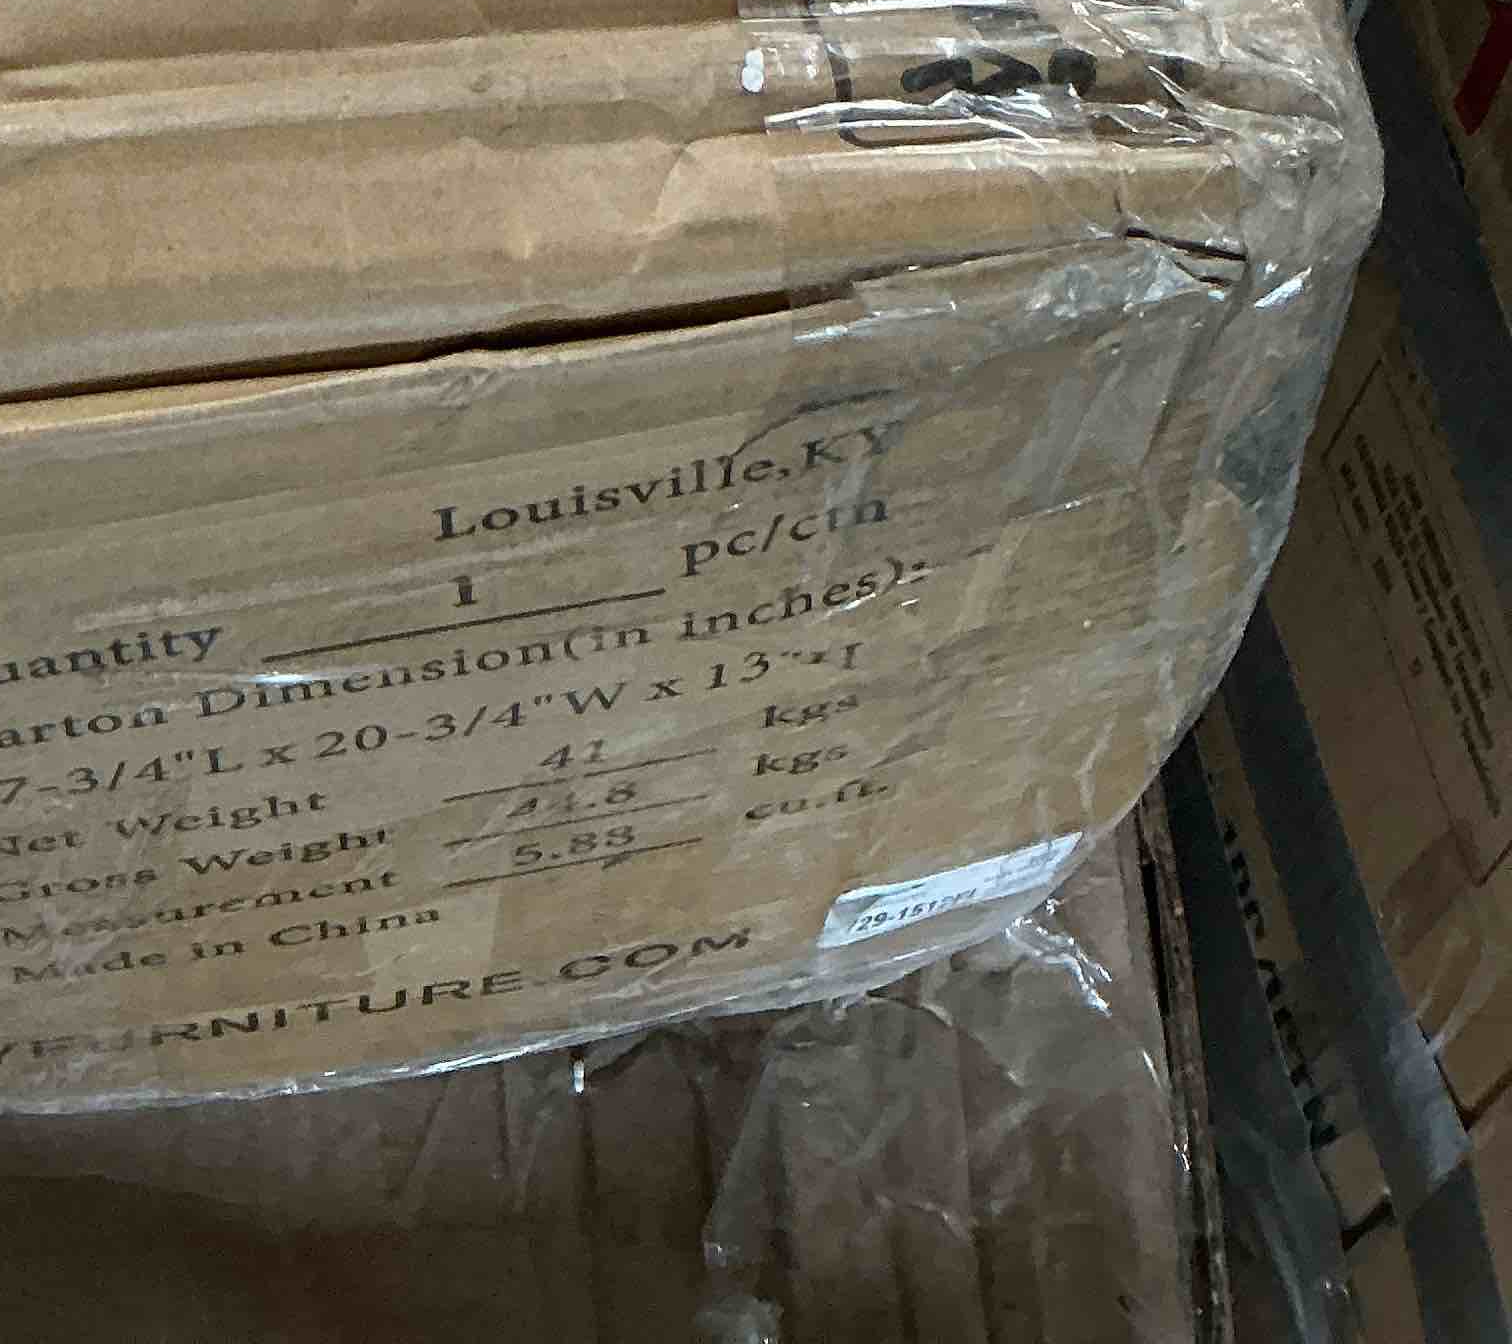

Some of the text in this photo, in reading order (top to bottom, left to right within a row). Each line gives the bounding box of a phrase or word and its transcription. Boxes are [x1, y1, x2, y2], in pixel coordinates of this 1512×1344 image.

[451, 575, 479, 609] 1
[261, 743, 297, 768] x
[643, 675, 686, 703] x
[107, 790, 328, 840] Weight
[539, 738, 607, 770] 41
[178, 827, 393, 877] Weight
[10, 907, 442, 987] Made in China
